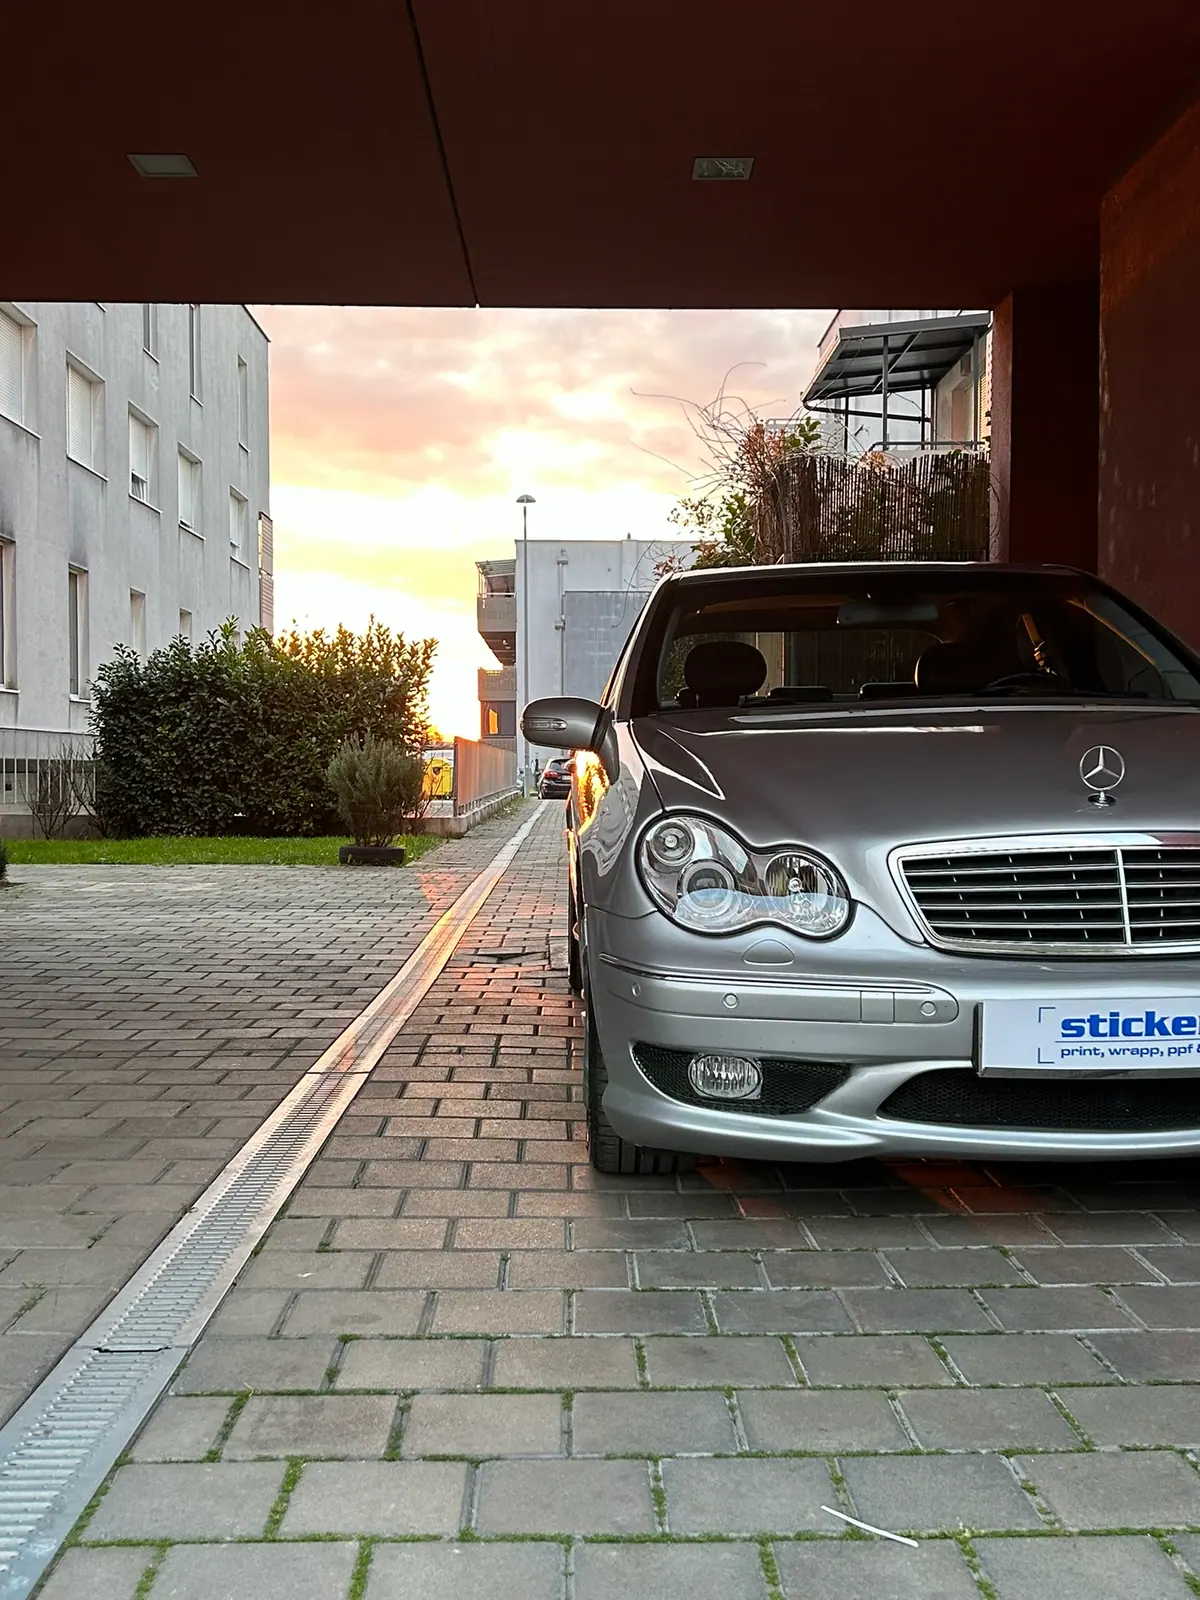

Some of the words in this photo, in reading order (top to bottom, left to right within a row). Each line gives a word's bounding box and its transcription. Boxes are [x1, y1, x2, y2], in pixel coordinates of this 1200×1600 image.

[1061, 1011, 1200, 1037] sticke
[1061, 1046, 1104, 1058] print,
[1108, 1046, 1164, 1058] wrapp,
[1168, 1044, 1194, 1057] ppf
